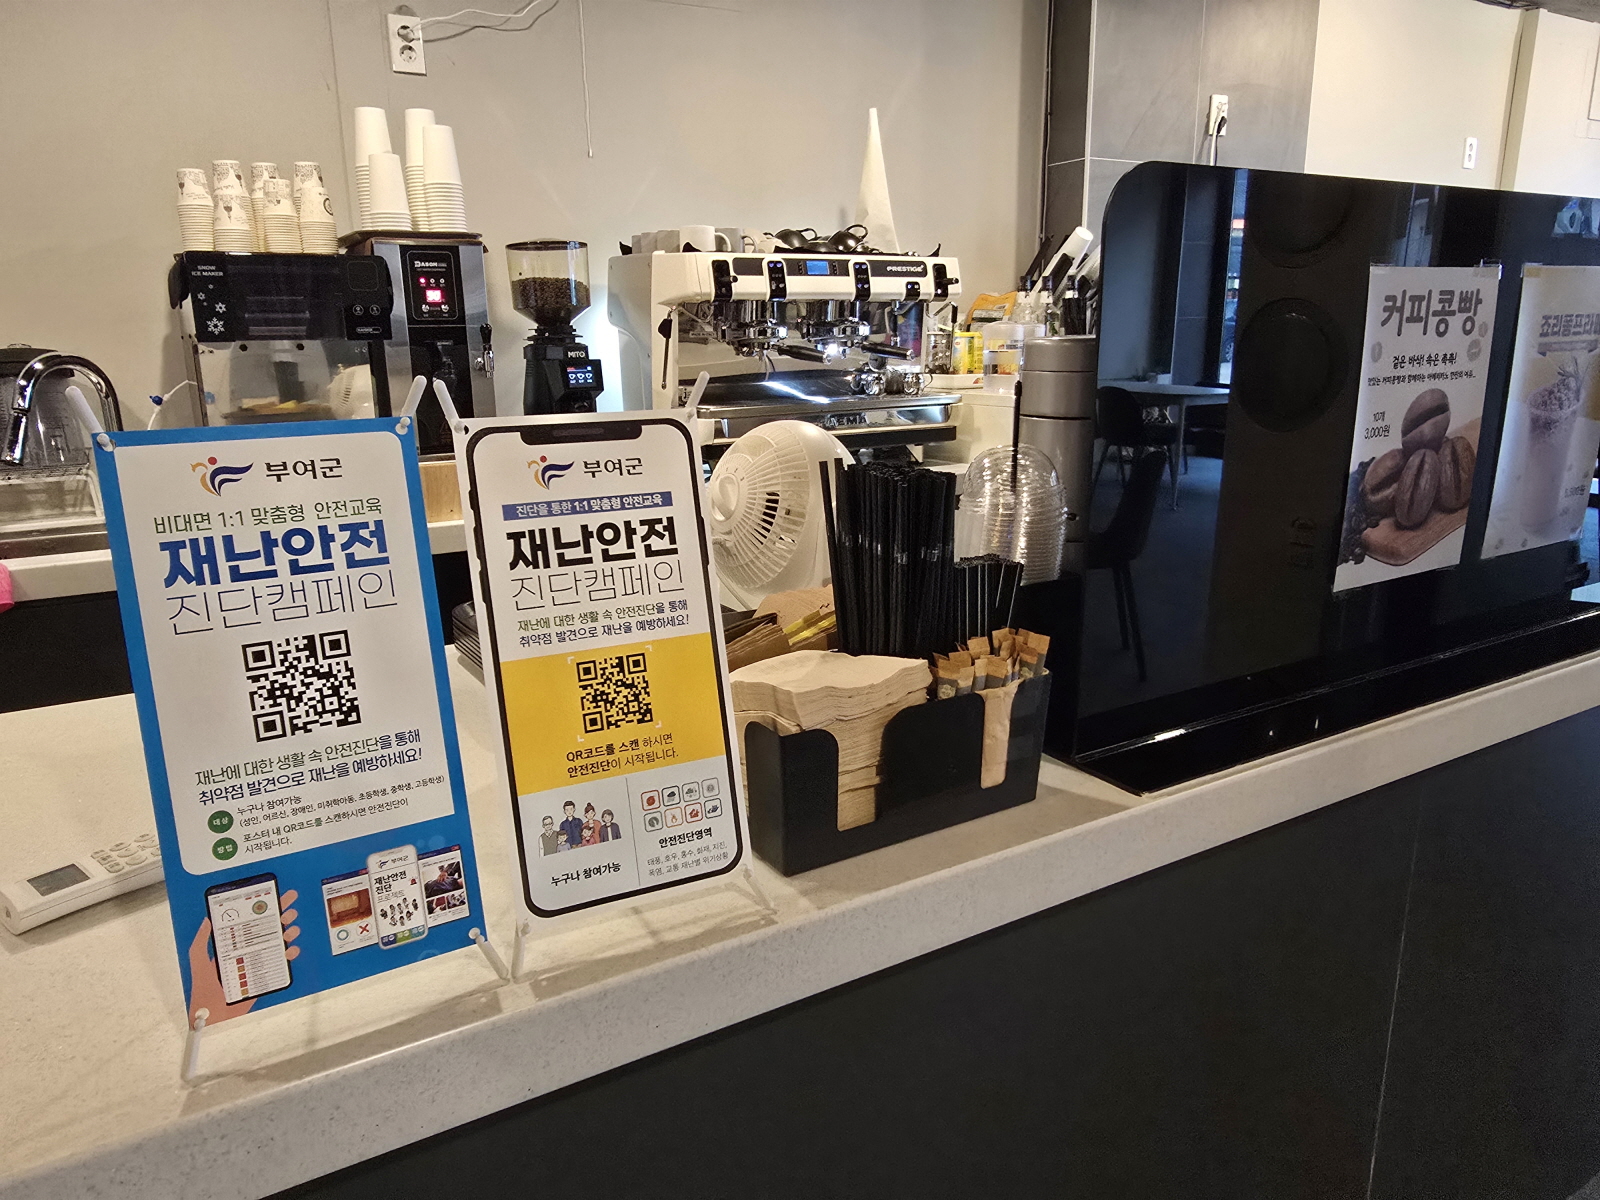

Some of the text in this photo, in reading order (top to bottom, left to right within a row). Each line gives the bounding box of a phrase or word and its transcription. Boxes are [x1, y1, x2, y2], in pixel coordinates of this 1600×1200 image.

[1381, 288, 1482, 338] 커피콩빵
[1392, 352, 1457, 370] 겉은 바삭! 속은 촉촉!
[1373, 411, 1385, 422] 10개
[1364, 425, 1390, 440] 3,000원
[264, 458, 343, 482] 부여군
[583, 457, 643, 479] 부여군
[154, 497, 382, 534] 비대면 1:1 맞춤형 안전교육
[516, 493, 662, 518] 진단을 통한 1:1 맞춤형 안전교육
[159, 519, 390, 588] 재난안전
[506, 516, 679, 570] 재난안전
[510, 559, 685, 611] 진단캠페인
[166, 569, 398, 635] 진단캠페인
[518, 599, 688, 631] 재난에 대한 생활 속 안전진단을 통해
[520, 614, 689, 647] 취약점 발견으로 재난을 예방하세요!
[195, 729, 421, 786] 재난에 대한 생활 속 안전진단을 통해
[566, 733, 672, 762] QR코드를 스캔 하시면
[568, 747, 679, 778] 안전진단이 시작됩니다.
[199, 748, 422, 806] 취약점 발견으로 재난을 예방하세요!
[237, 795, 302, 815] 누구나 참여가능
[243, 798, 408, 842] 포스터 내 QR코드를 스캔하시면 안전진단이
[245, 837, 292, 854] 시작됩니다.
[659, 827, 713, 848] 안전진단영역
[374, 870, 406, 885] 재난안전
[551, 862, 621, 887] 누구나 참여가능
[666, 864, 679, 873] 교통
[376, 884, 392, 894] 진단
